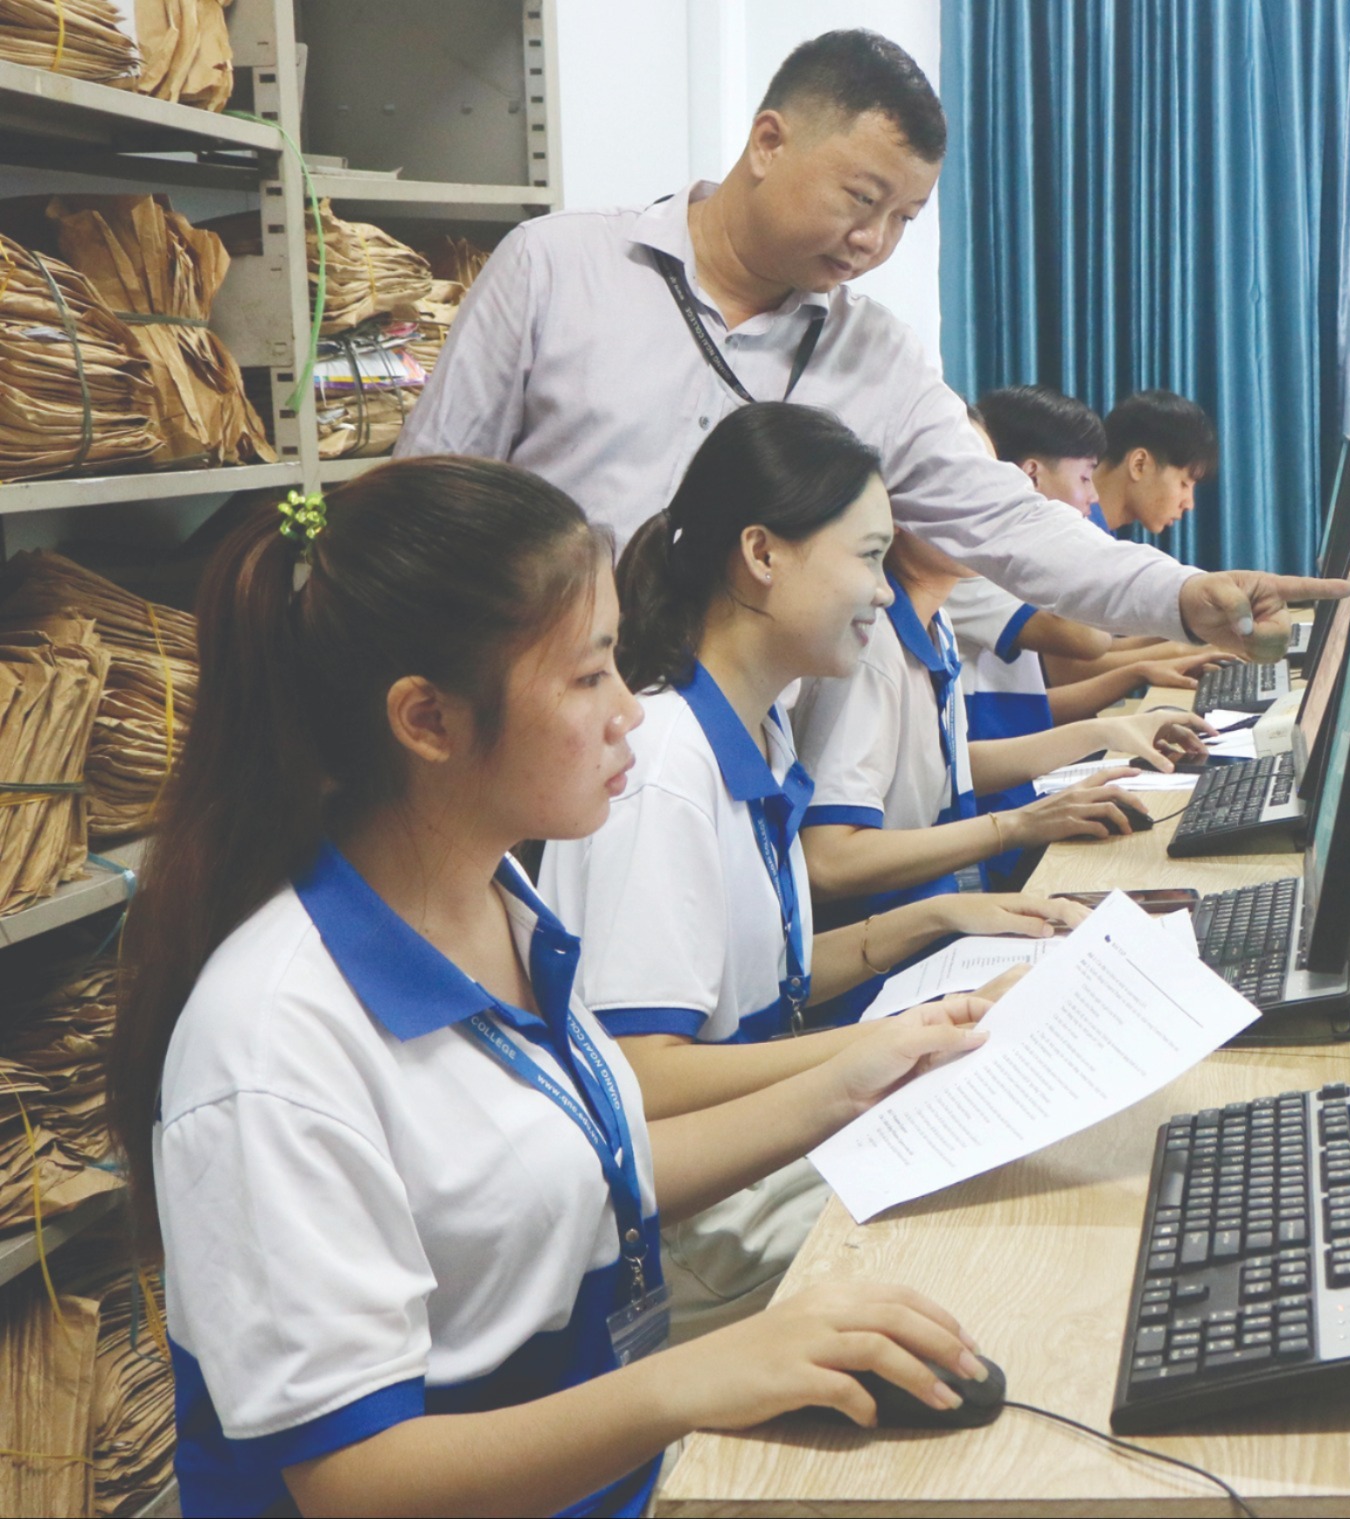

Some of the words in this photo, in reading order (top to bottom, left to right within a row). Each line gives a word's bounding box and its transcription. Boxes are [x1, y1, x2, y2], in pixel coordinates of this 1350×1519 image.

[685, 306, 705, 340] COLLEGE
[470, 1016, 516, 1060] COLLEGE
[584, 1042, 603, 1068] NGAI
[602, 1069, 620, 1111] QUANG
